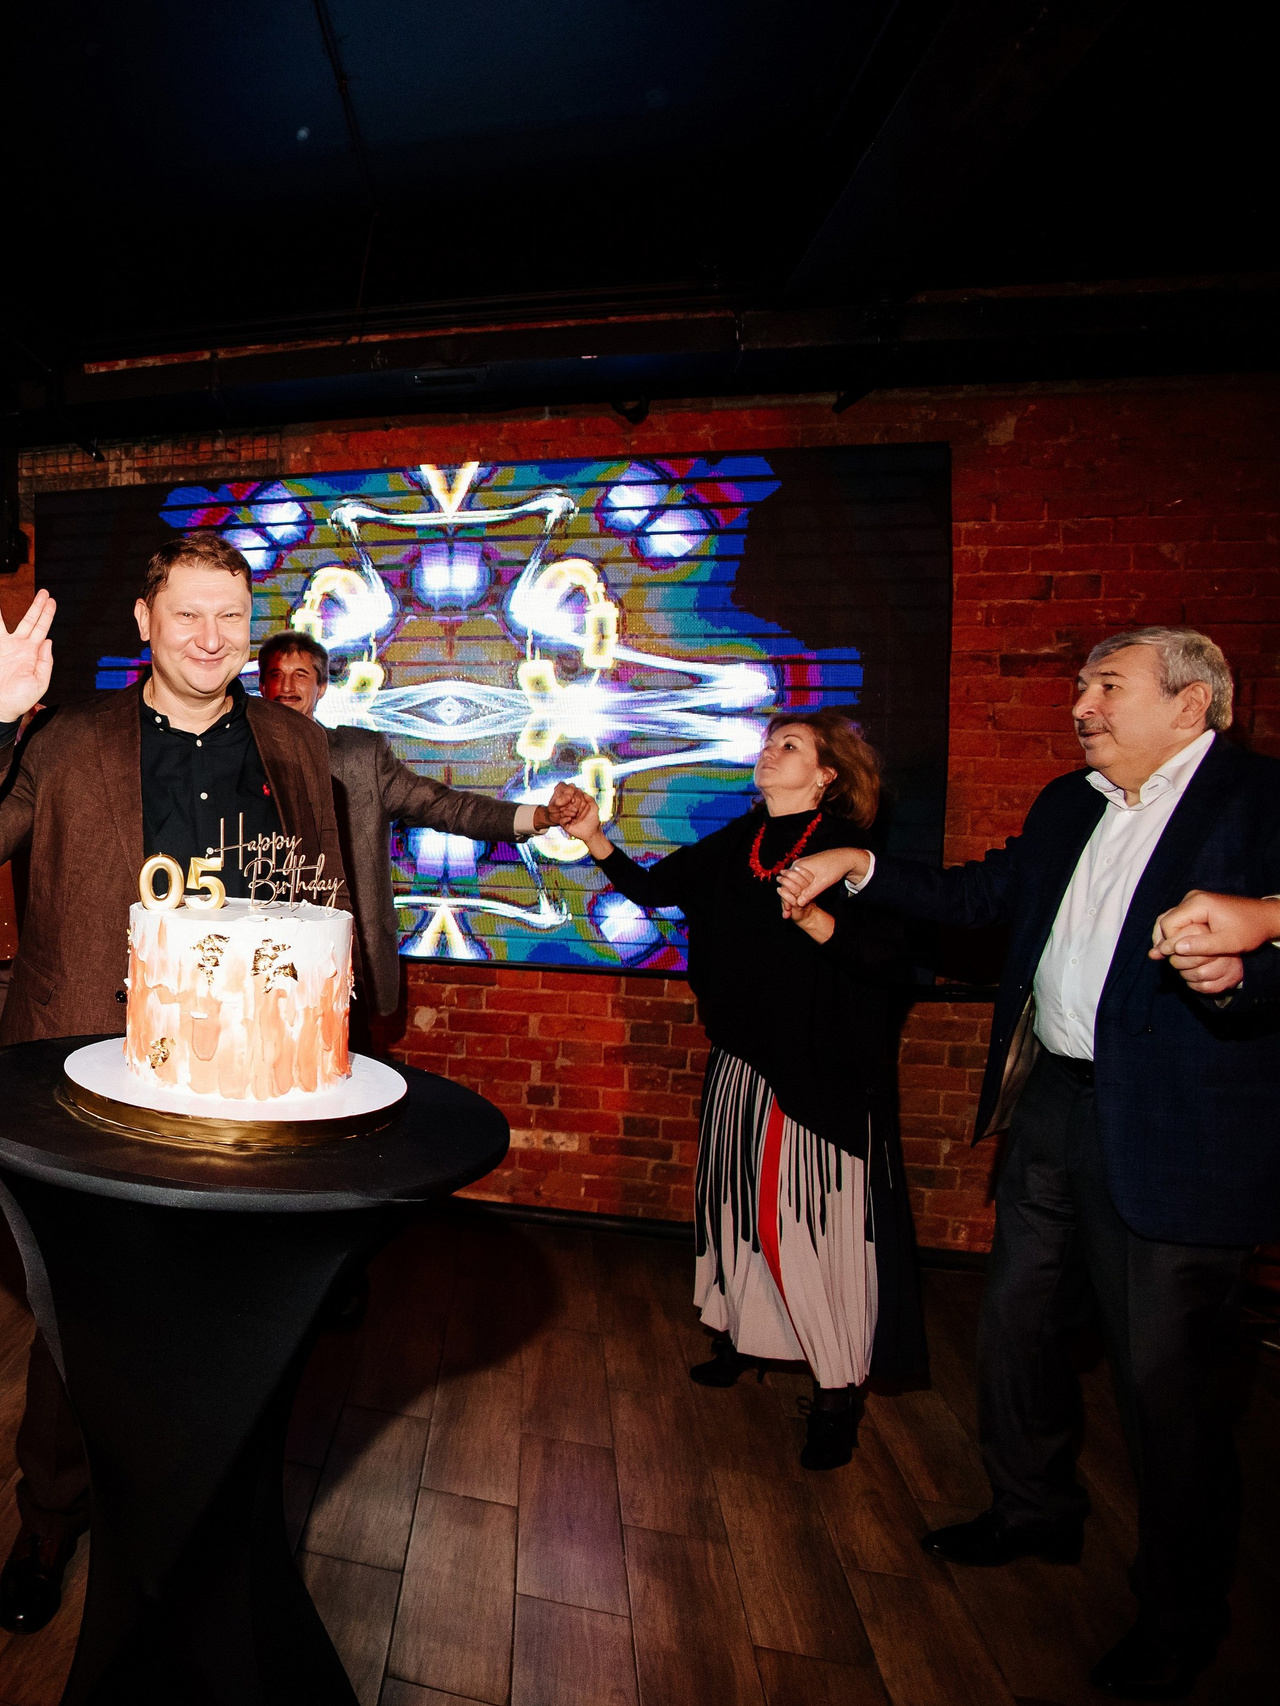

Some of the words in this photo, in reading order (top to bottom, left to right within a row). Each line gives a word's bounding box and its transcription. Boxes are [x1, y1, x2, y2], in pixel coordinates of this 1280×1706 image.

[214, 812, 302, 876] Happy
[138, 853, 226, 910] 05
[244, 853, 344, 917] Birthday
